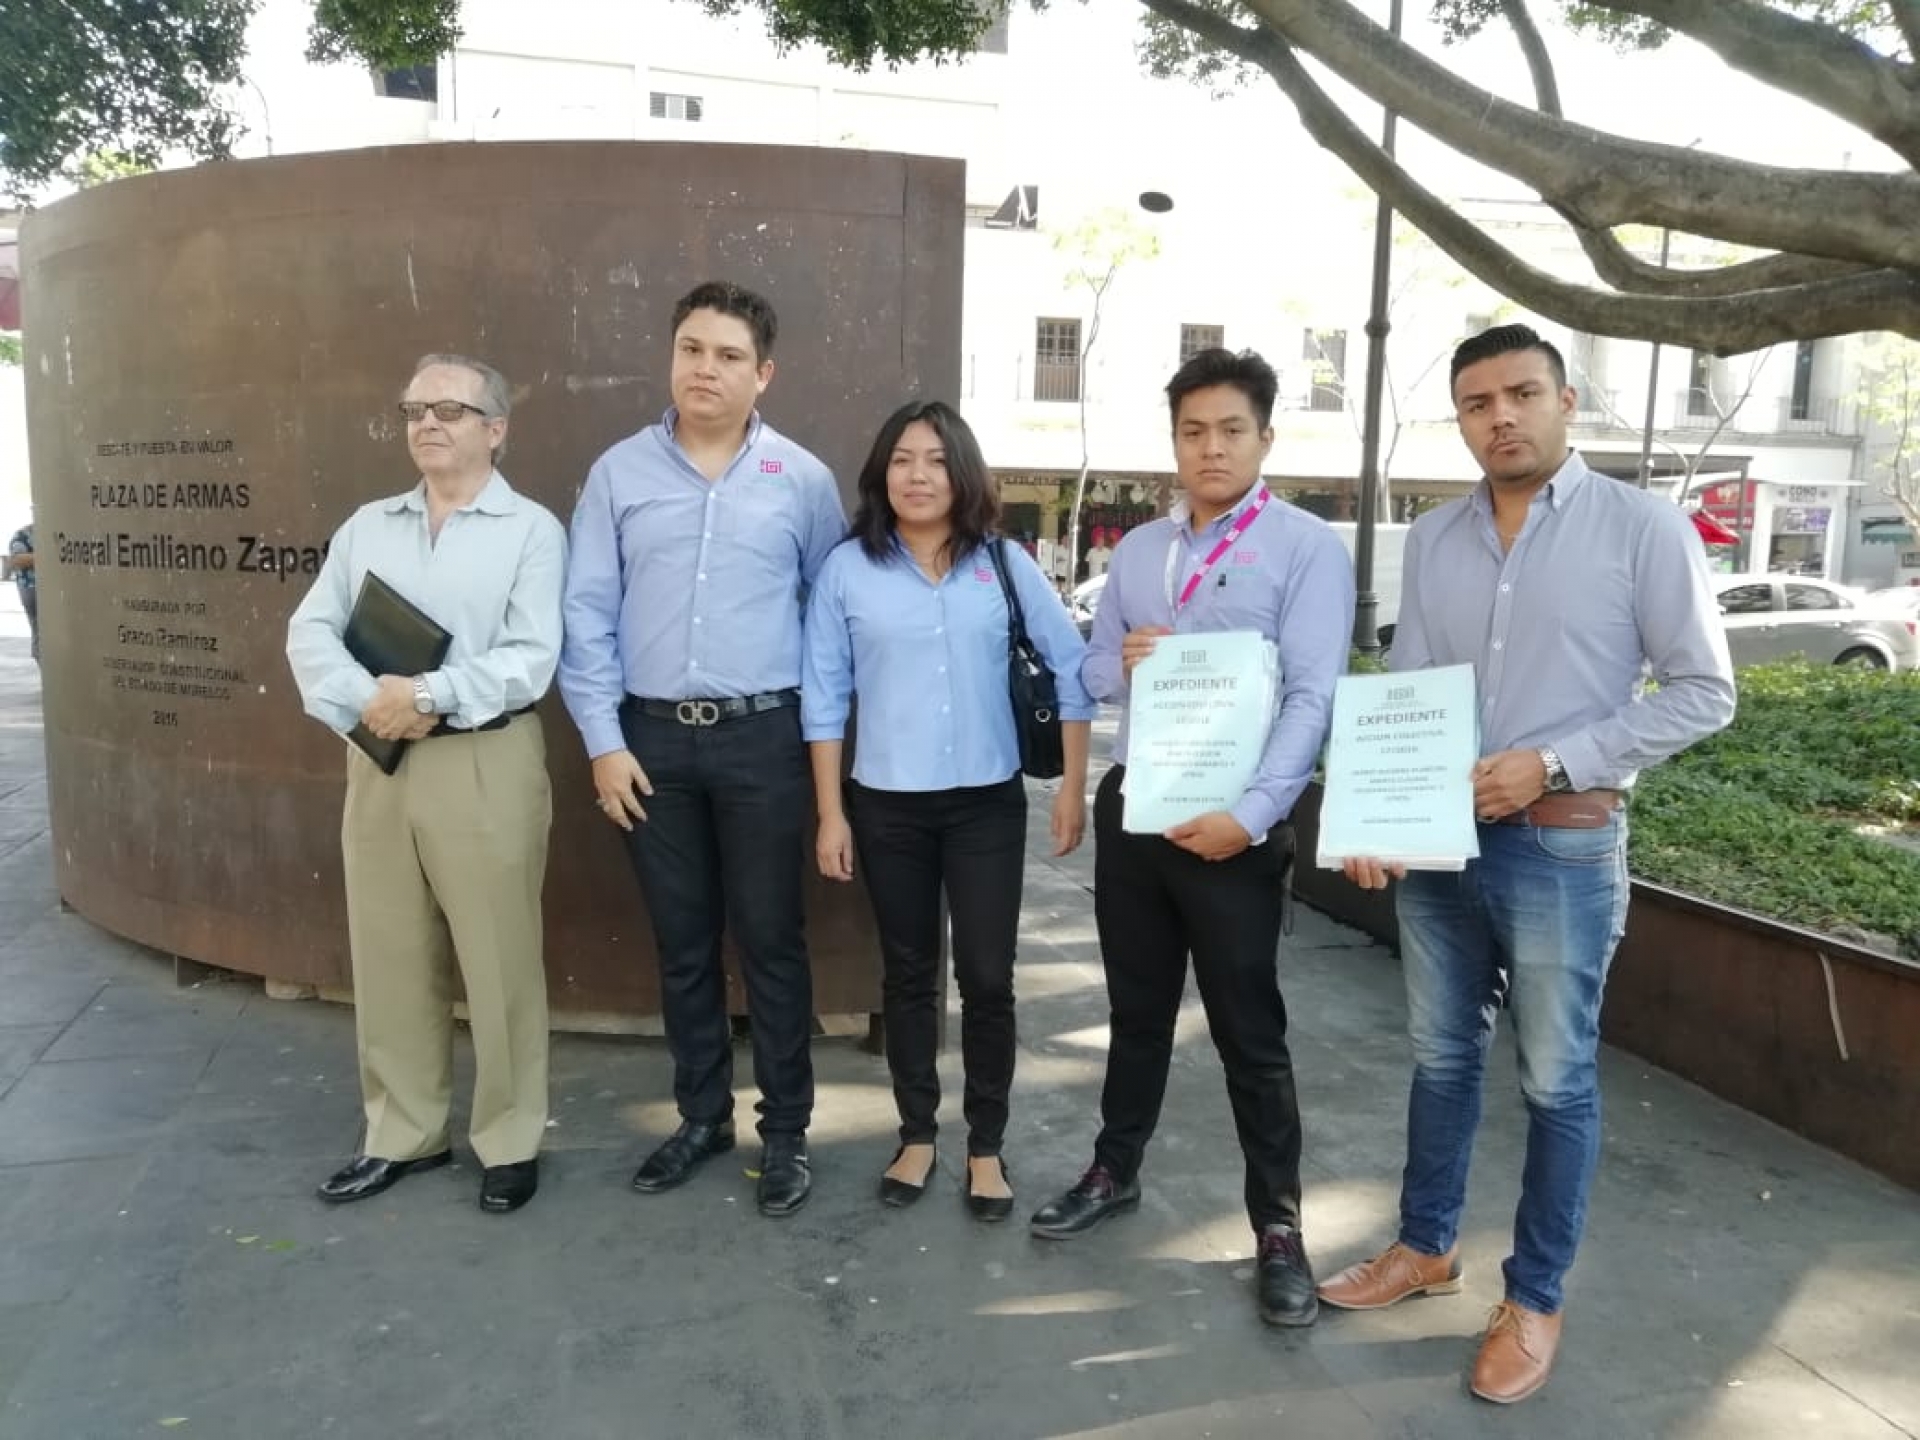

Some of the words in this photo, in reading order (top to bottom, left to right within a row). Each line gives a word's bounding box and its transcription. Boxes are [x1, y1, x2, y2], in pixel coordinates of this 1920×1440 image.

[91, 484, 138, 508] PLAZA
[143, 483, 168, 508] DE
[173, 483, 250, 509] ARMAS
[117, 532, 227, 571] Emiliano
[1153, 677, 1238, 691] EXPEDIENTE
[1357, 708, 1448, 726] EXPEDIENTE
